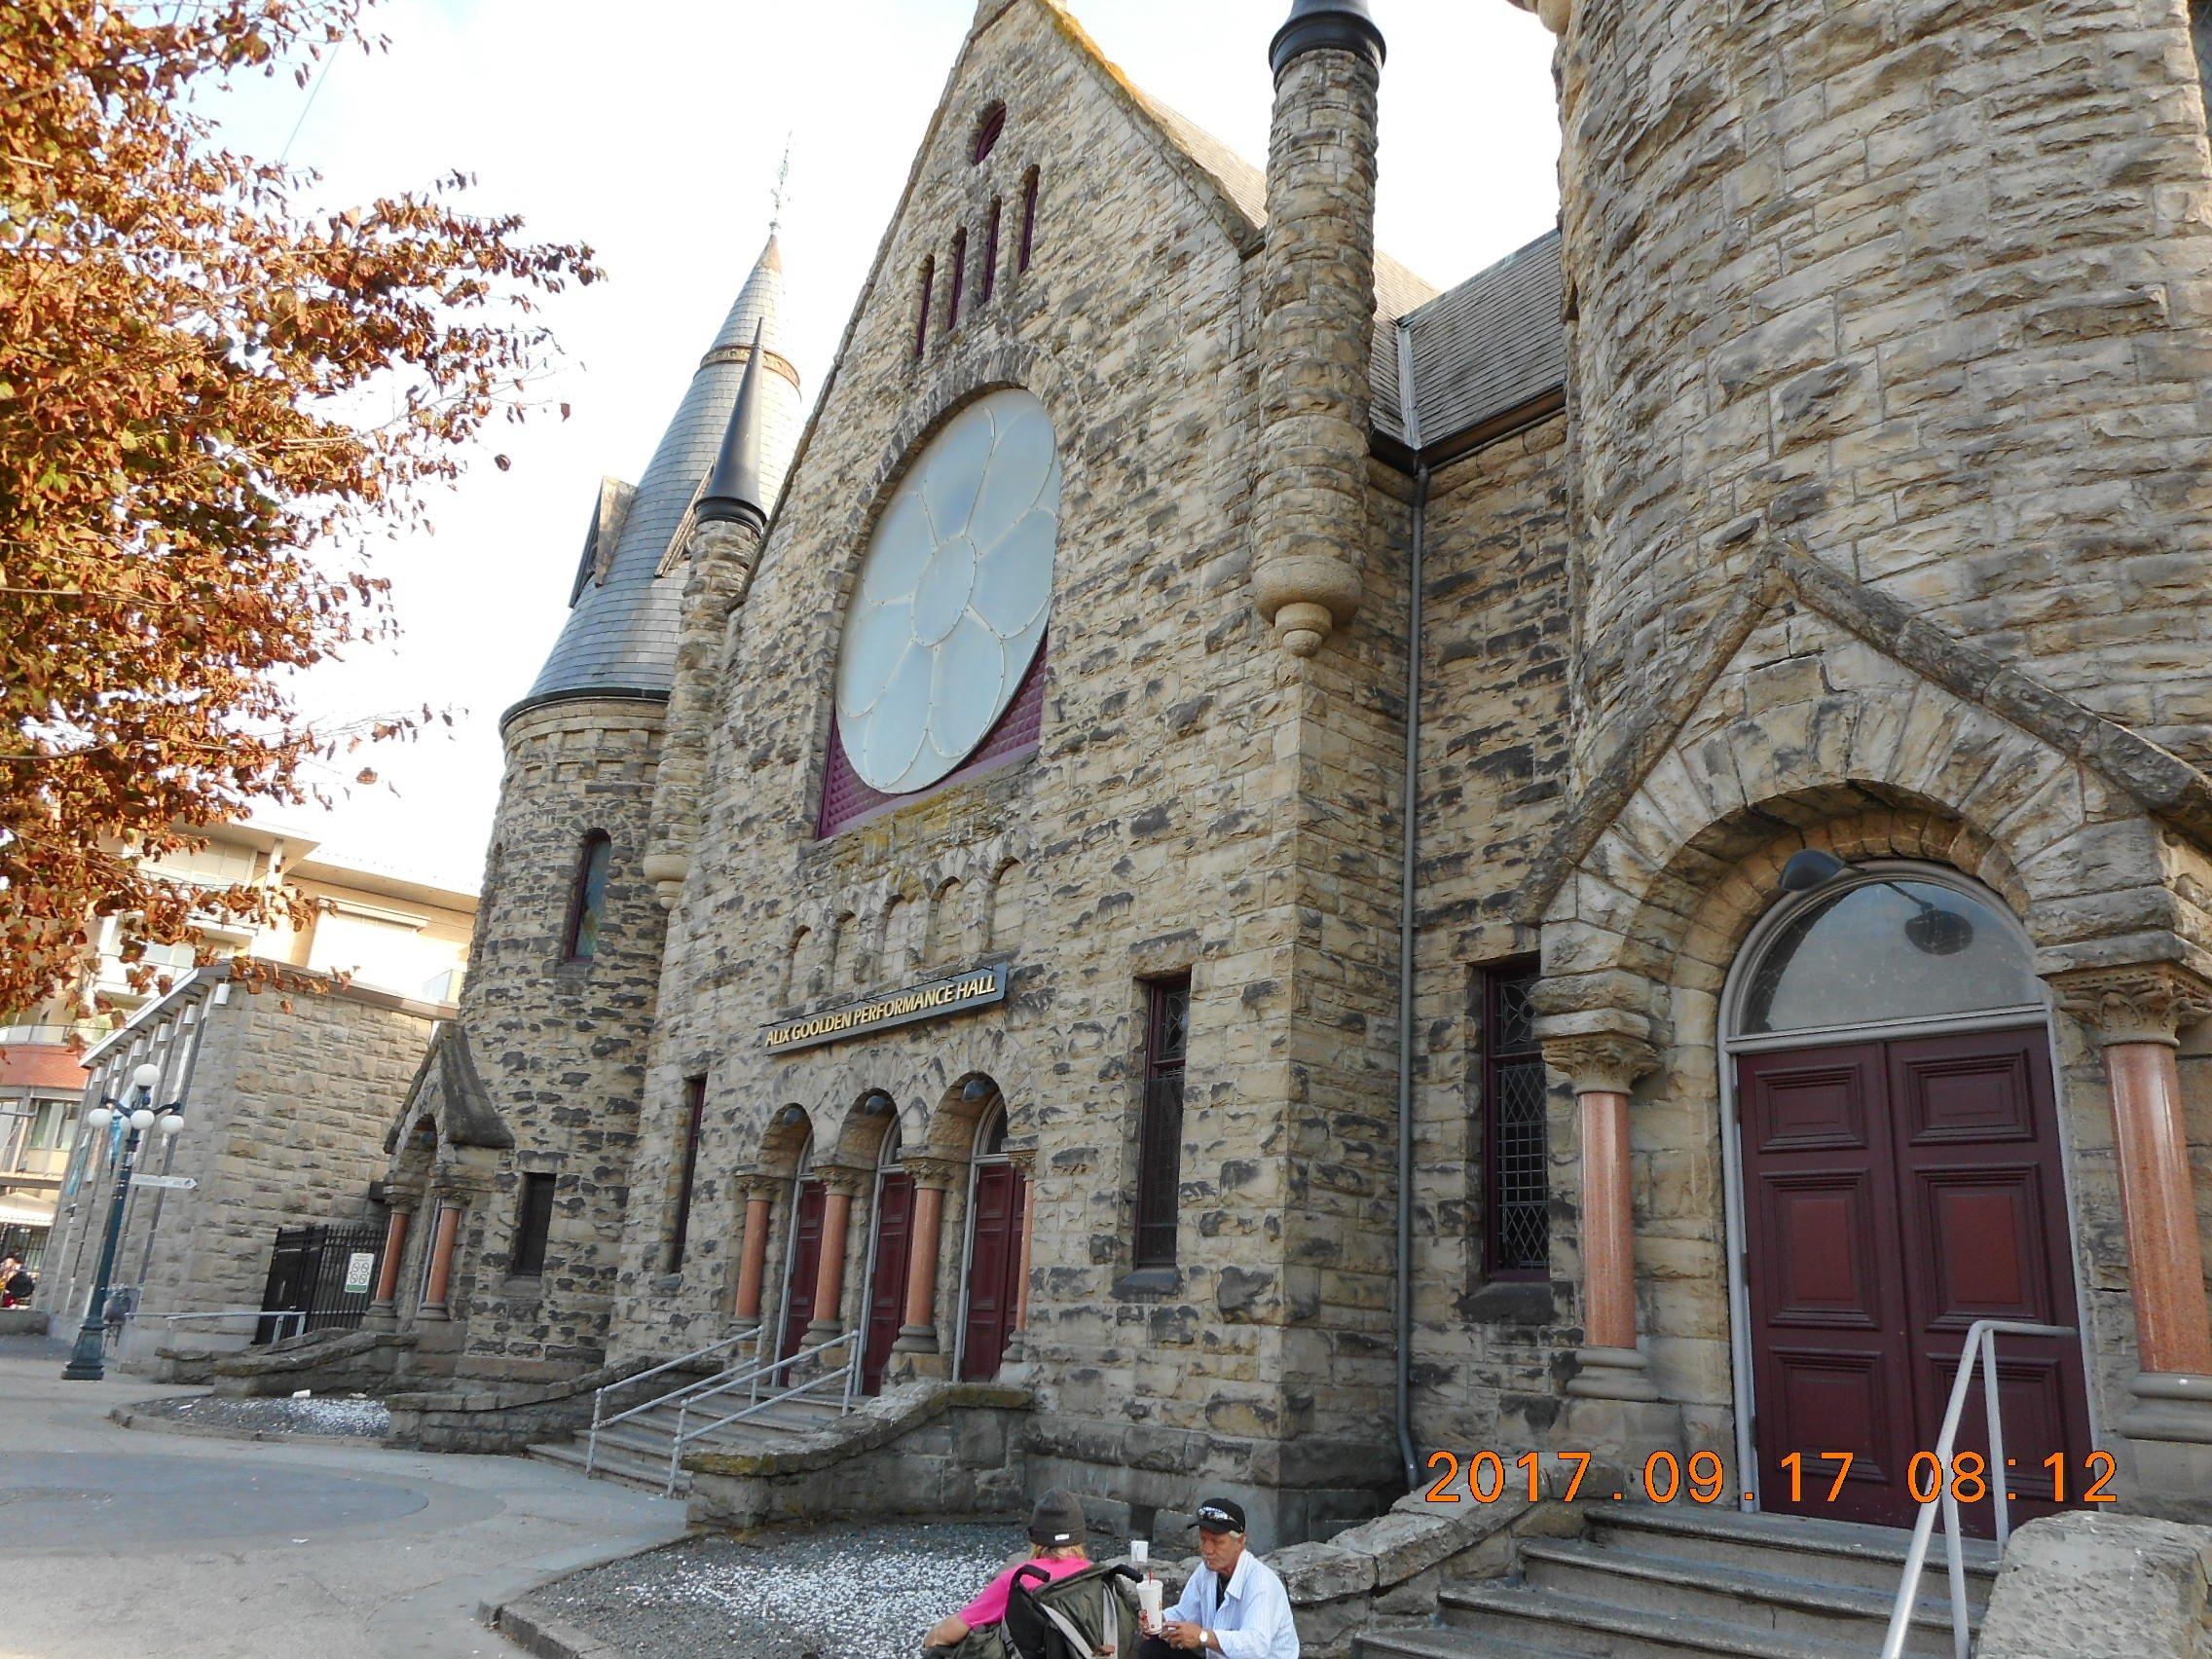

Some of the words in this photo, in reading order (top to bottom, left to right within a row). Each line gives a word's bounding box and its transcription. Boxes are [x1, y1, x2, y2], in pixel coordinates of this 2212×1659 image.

[765, 1027, 790, 1047] ALIX
[792, 1012, 852, 1040] GOOLDEN
[853, 985, 954, 1026] PERFORMANCE
[956, 975, 996, 1000] HALL
